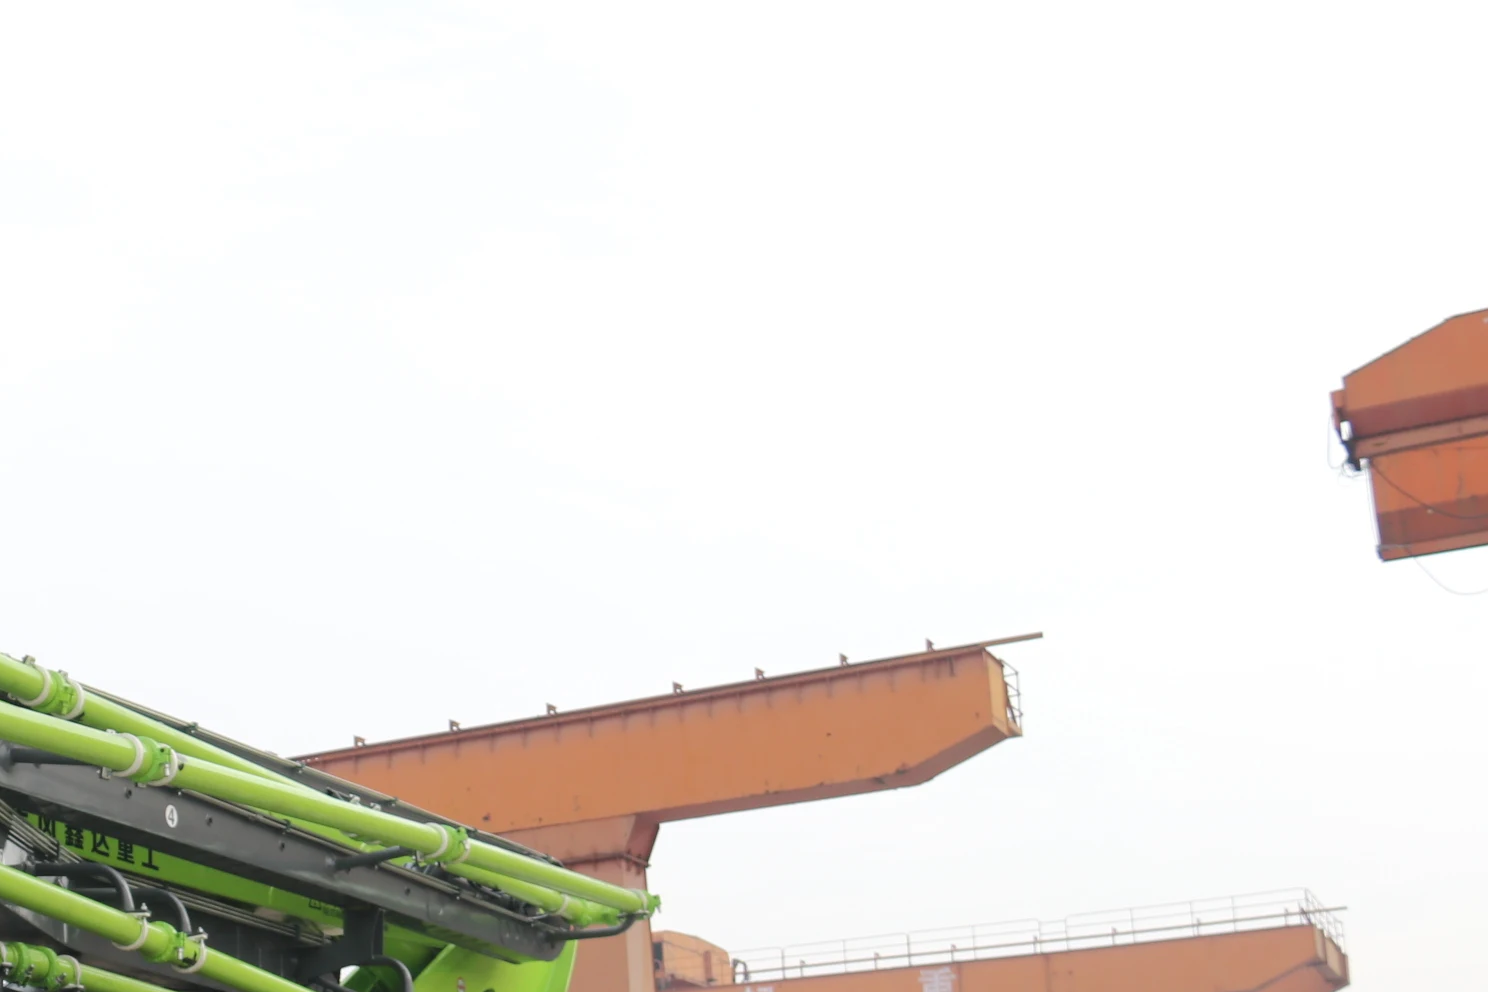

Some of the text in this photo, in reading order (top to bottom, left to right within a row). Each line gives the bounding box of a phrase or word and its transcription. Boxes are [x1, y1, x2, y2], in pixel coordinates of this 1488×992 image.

[19, 808, 160, 871] 风鑫达重工
